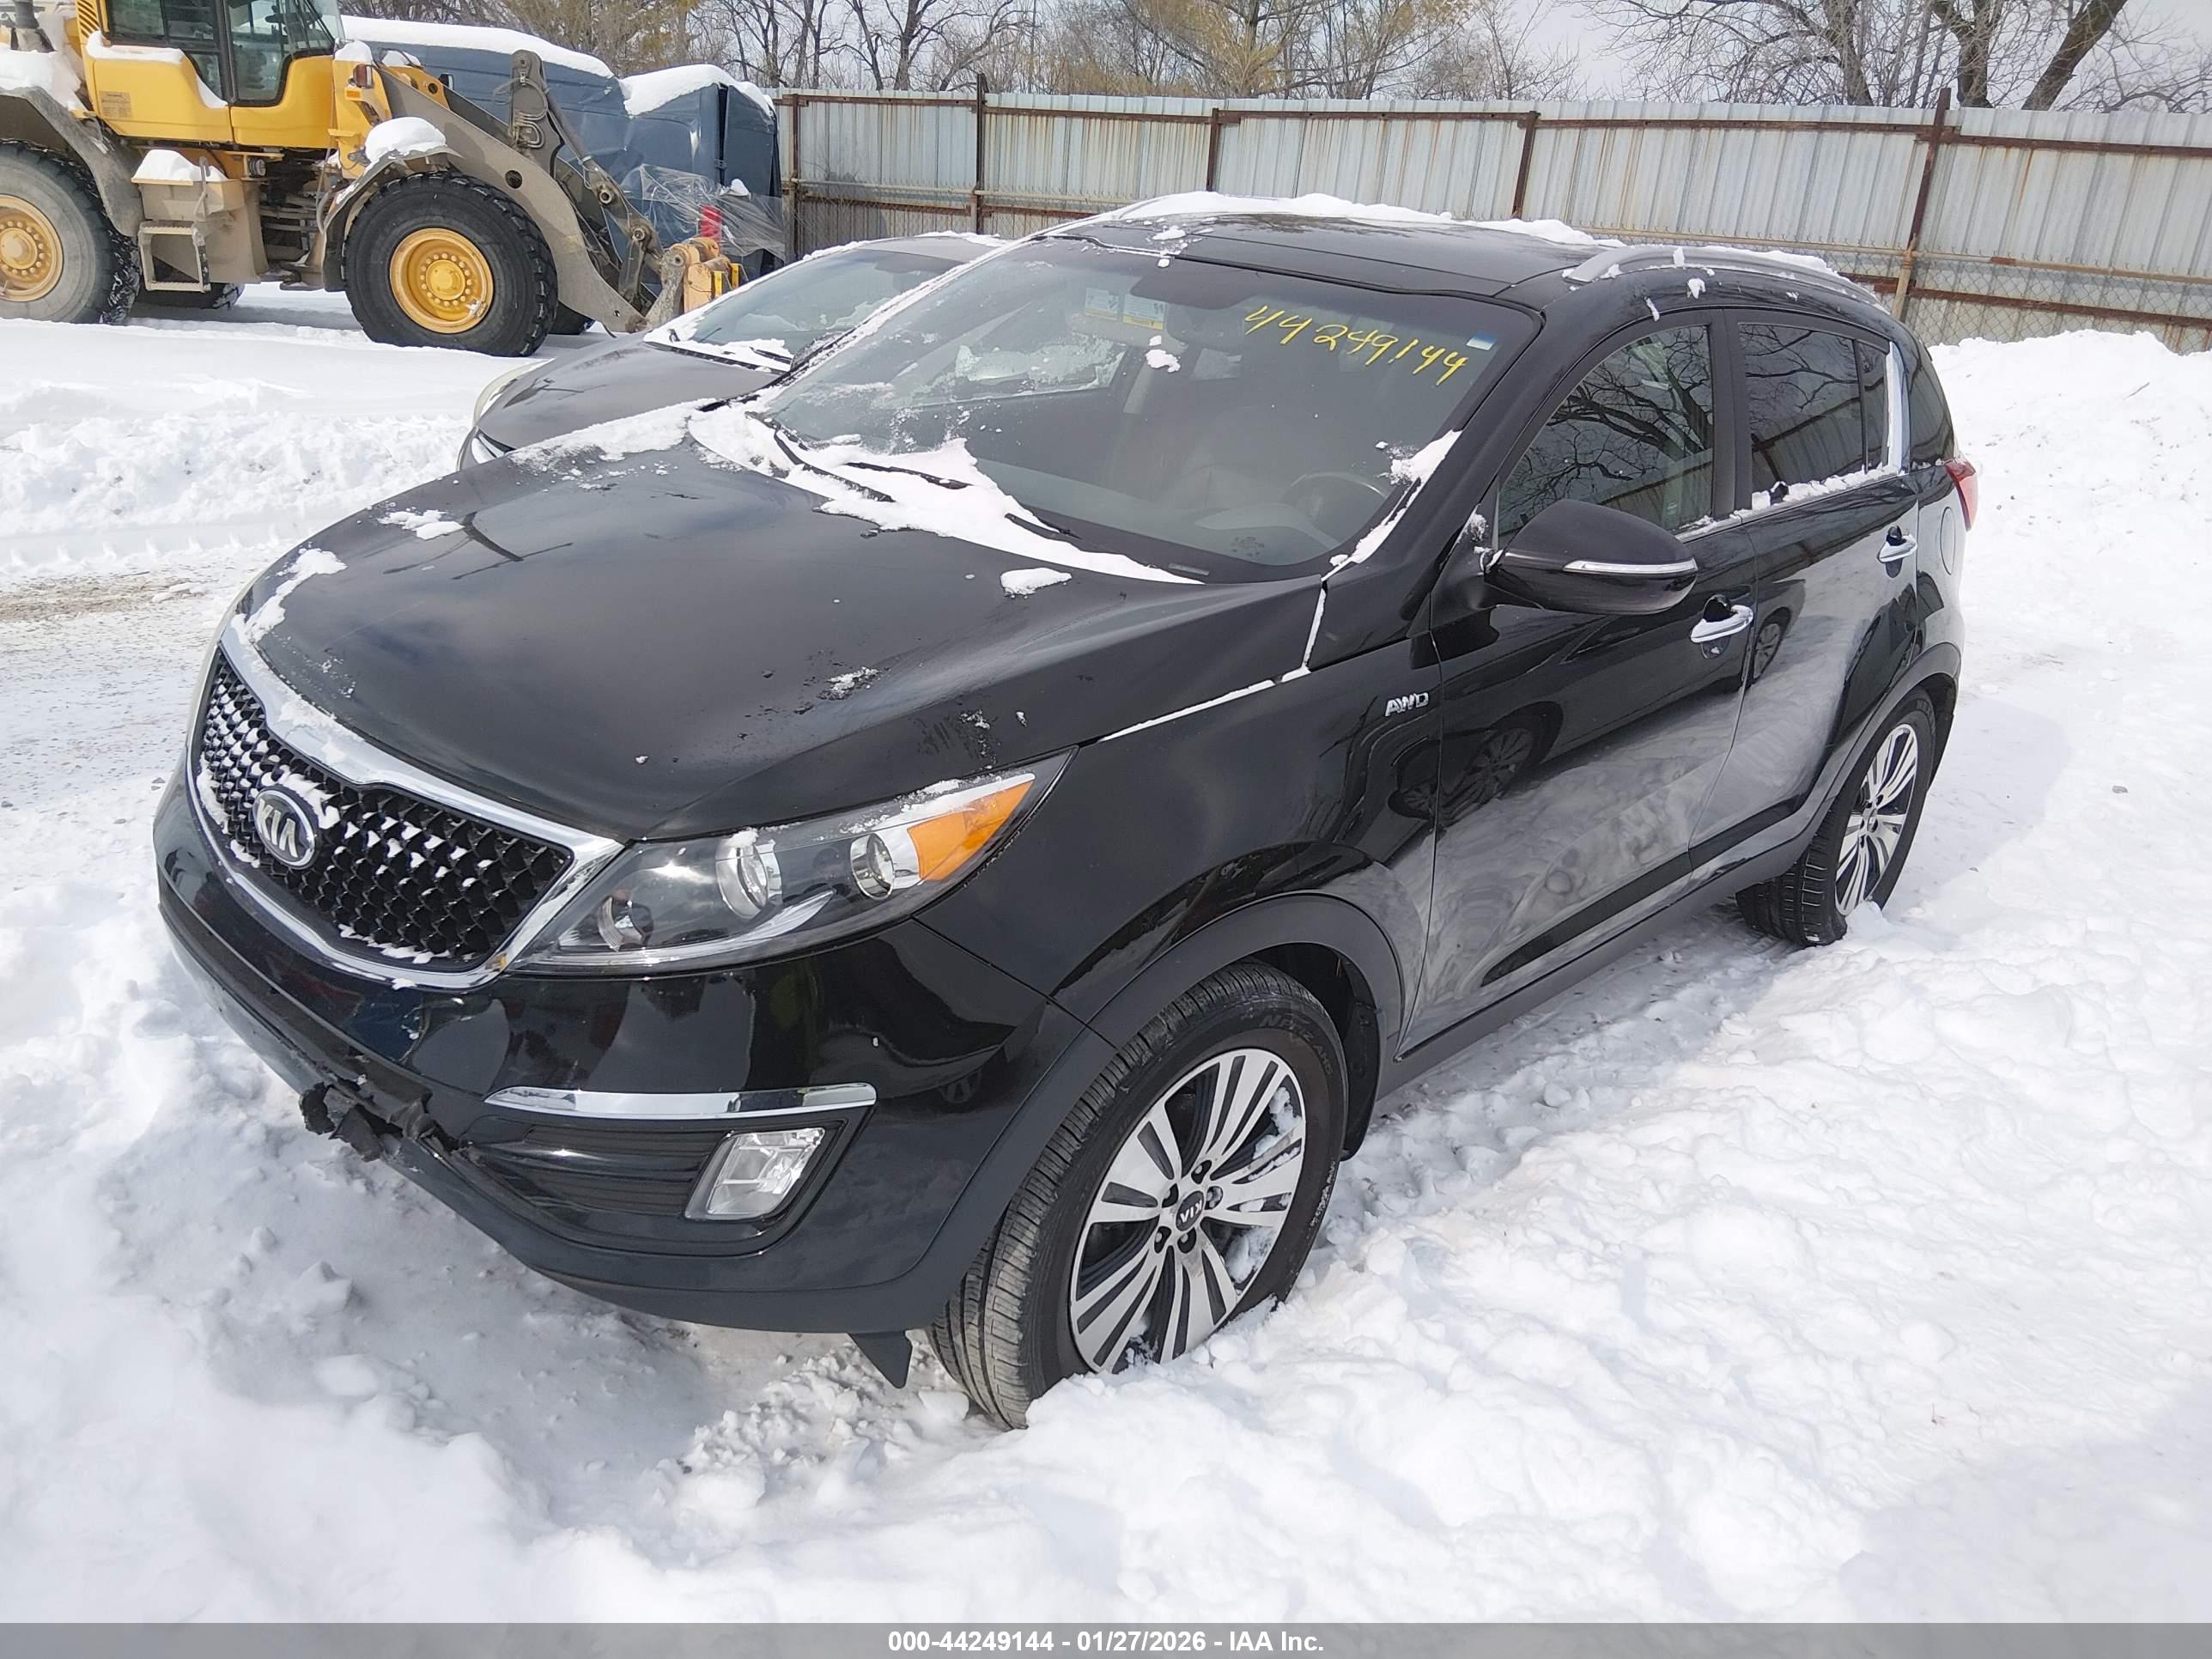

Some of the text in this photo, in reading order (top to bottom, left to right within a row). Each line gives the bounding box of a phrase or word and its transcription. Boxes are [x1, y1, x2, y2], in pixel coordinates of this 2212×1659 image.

[1244, 305, 1469, 386] 44249144
[1383, 691, 1430, 717] AWD
[256, 798, 299, 859] KIA
[1179, 1199, 1203, 1224] KIA
